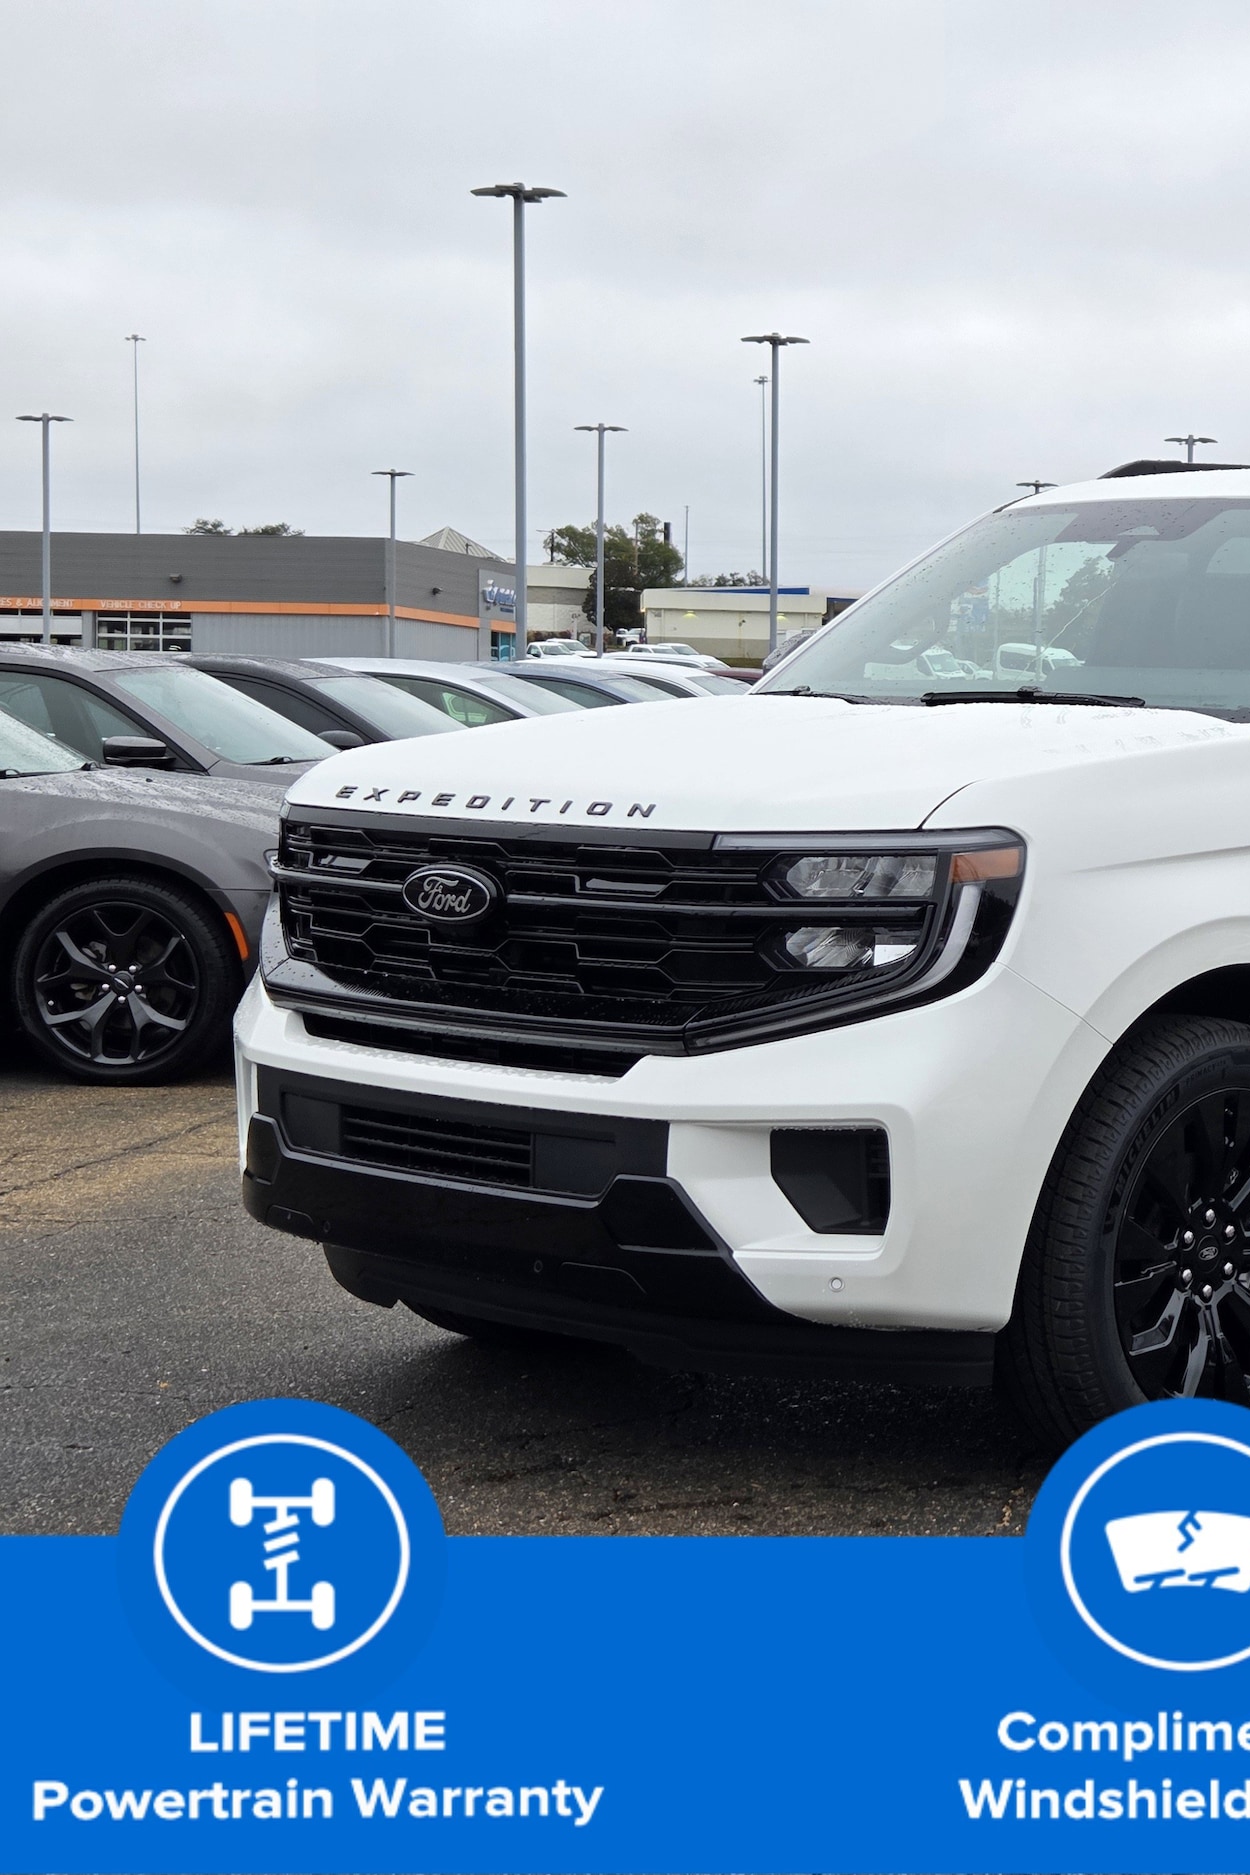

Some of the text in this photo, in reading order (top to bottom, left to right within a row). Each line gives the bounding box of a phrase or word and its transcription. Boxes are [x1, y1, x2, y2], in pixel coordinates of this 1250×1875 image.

[15, 598, 23, 607] &
[100, 599, 182, 610] VEHICLE CHECK UP
[335, 785, 656, 818] EXPEDITION
[418, 875, 472, 914] Ford
[1114, 1084, 1181, 1198] MICHELIN
